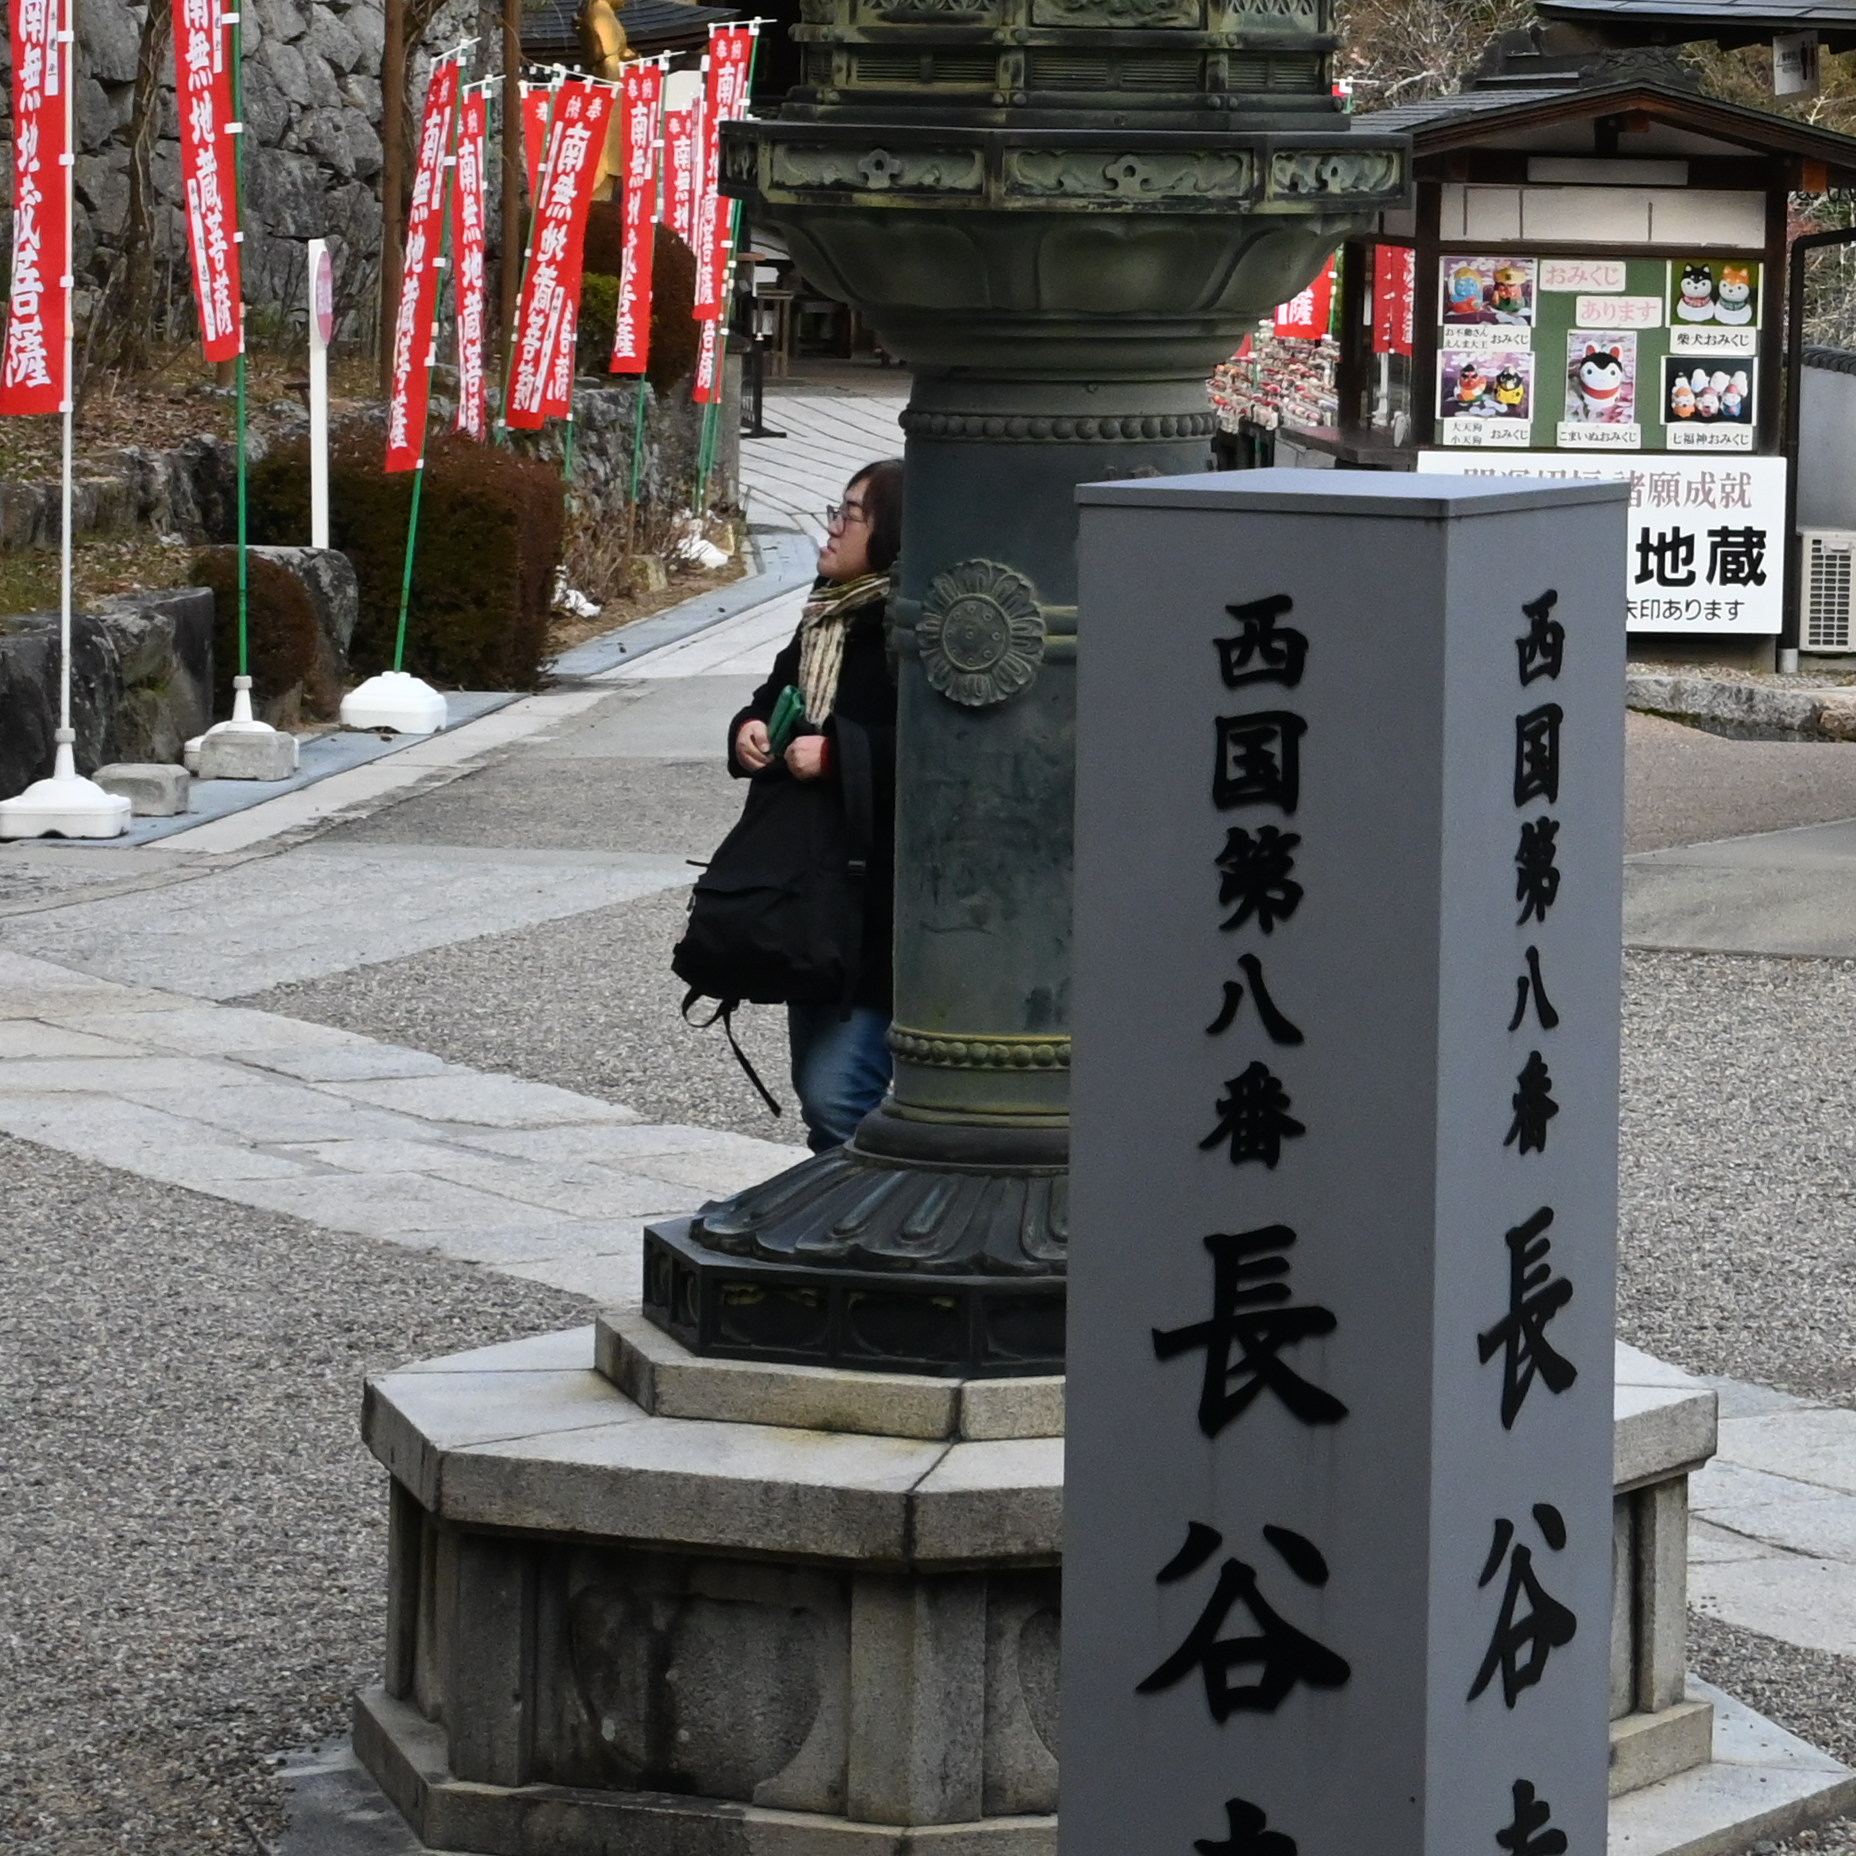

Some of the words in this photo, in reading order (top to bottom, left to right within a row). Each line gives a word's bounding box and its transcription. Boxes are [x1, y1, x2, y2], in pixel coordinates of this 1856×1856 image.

[1546, 265, 1620, 286] おみくじ
[1581, 301, 1657, 322] あります
[1490, 334, 1529, 345] おみくじ
[1677, 332, 1750, 347] 柴犬おみくじ
[1490, 430, 1529, 441] おみくじ
[1559, 430, 1638, 444] こまいぬおみくじ
[1673, 432, 1750, 445] 七福神おみくじ
[1634, 526, 1767, 587] 地蔵
